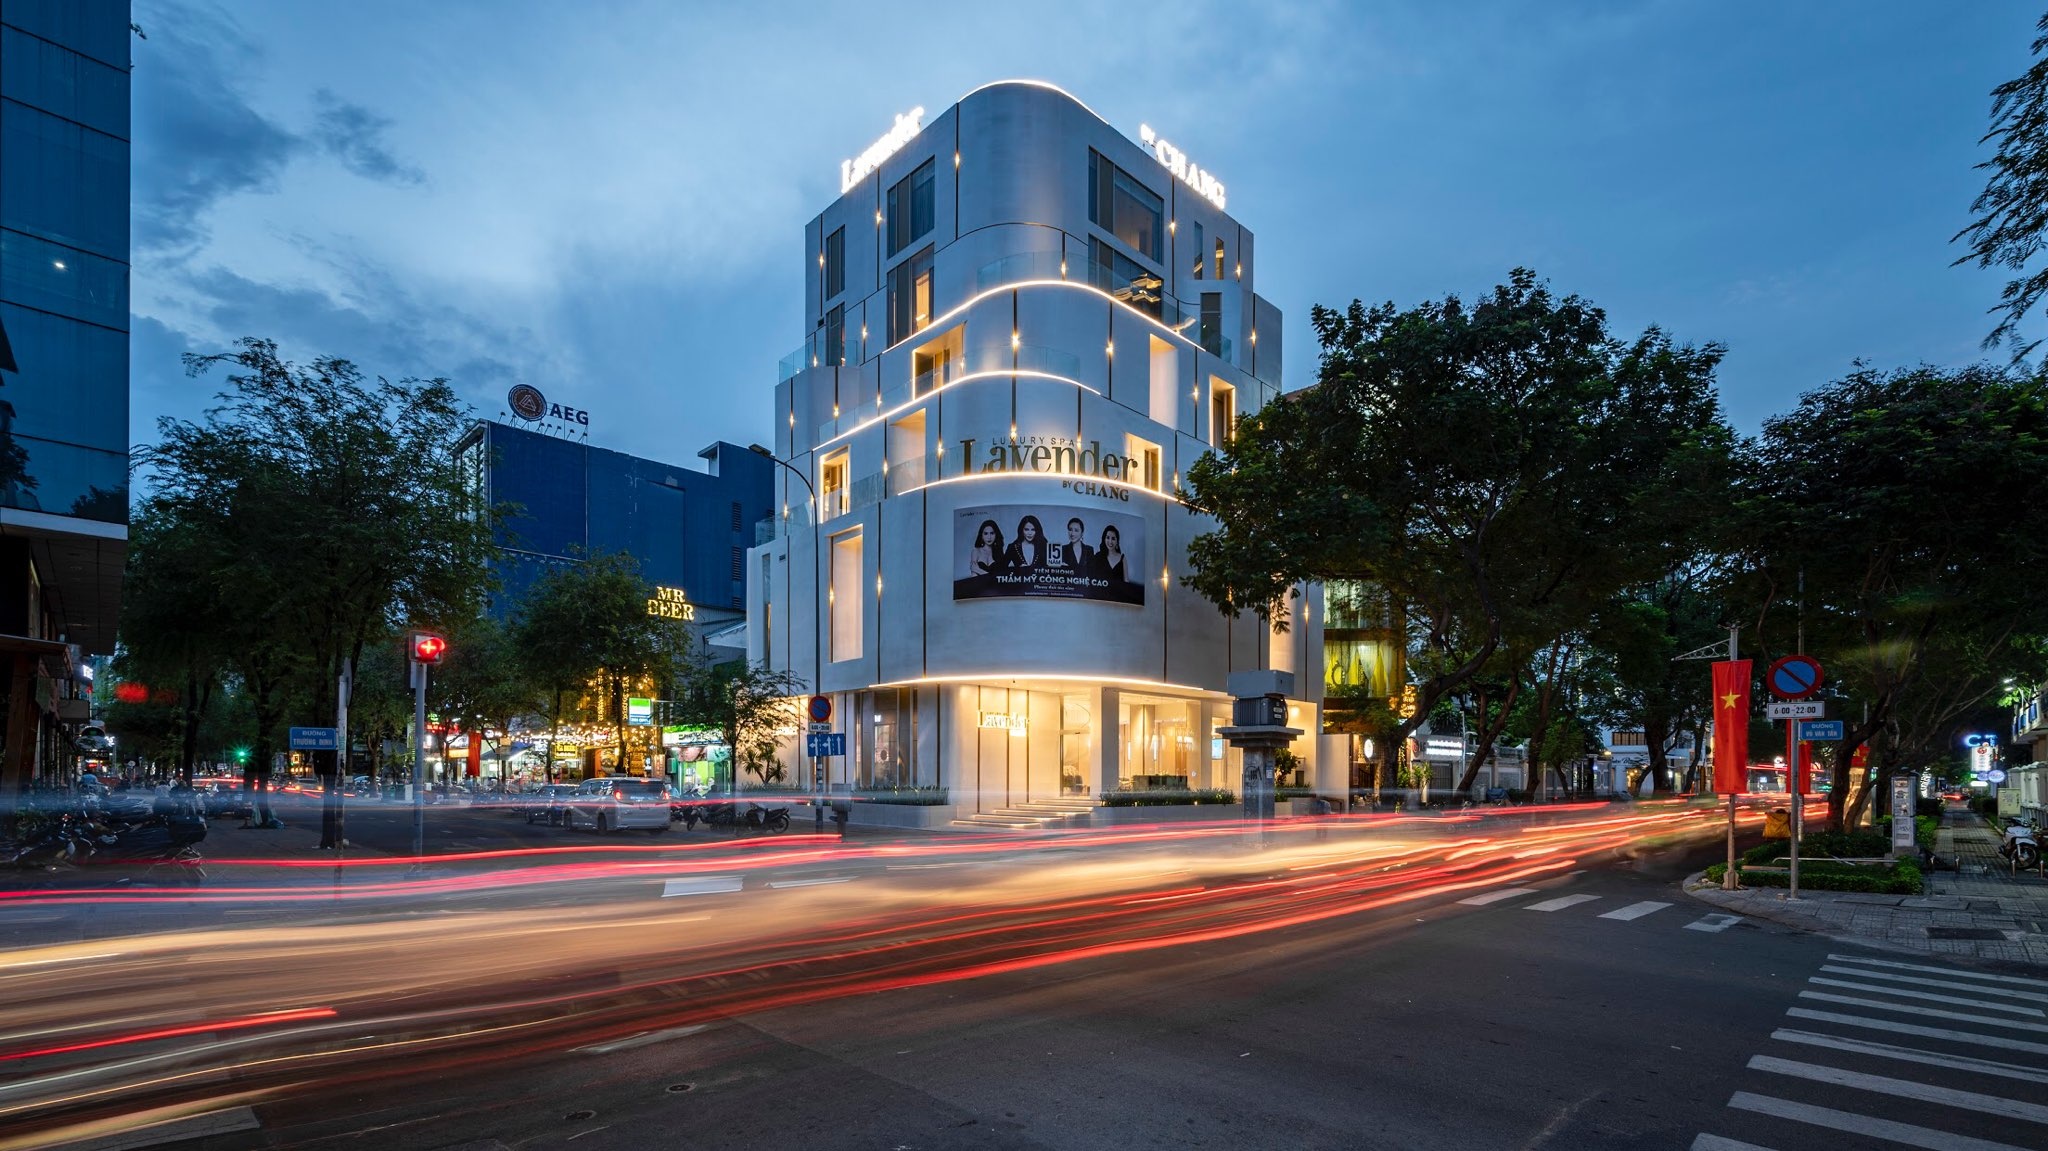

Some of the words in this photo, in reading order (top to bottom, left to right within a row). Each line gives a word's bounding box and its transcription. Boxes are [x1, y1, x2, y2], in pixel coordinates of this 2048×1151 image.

[1156, 139, 1226, 209] CHANG
[549, 403, 589, 426] AEG
[992, 436, 1045, 446] LUXURY
[1050, 437, 1076, 447] SPA
[960, 438, 1138, 483] Lavender
[1062, 480, 1073, 489] BY
[1073, 481, 1129, 502] CHANG
[1048, 543, 1061, 559] 15
[996, 572, 1022, 583] THẨM
[1023, 574, 1037, 583] MỸ
[1039, 574, 1065, 584] CÔNG
[1066, 576, 1090, 587] NGHỆ
[1091, 578, 1109, 587] CAO
[656, 586, 685, 604] MR
[647, 599, 695, 621] DEER
